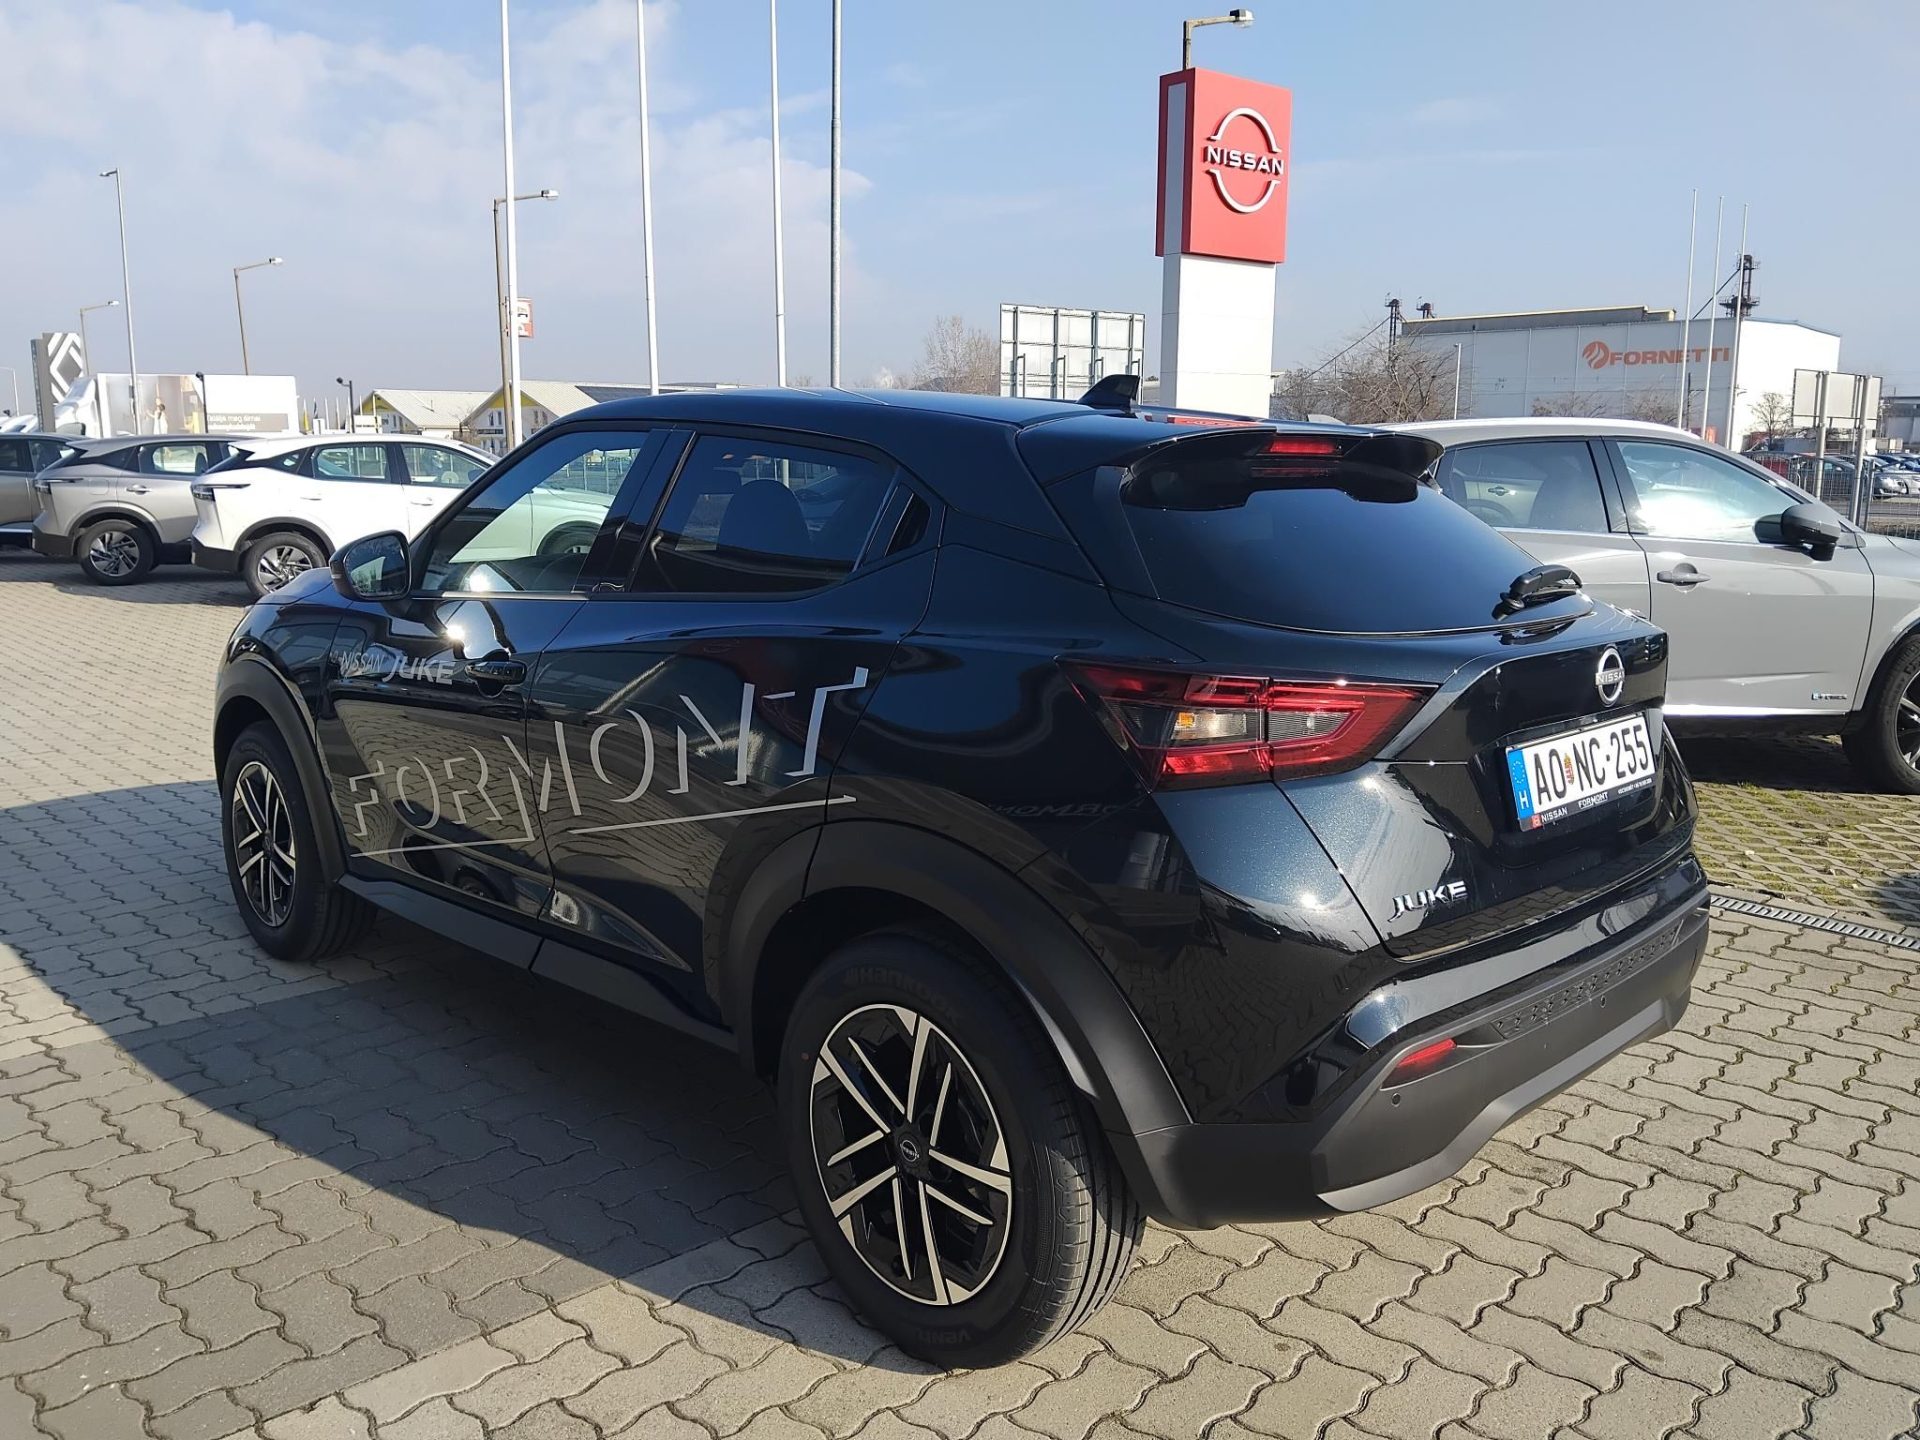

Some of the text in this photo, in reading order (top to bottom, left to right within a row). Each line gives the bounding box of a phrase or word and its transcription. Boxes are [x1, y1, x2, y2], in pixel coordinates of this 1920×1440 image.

[1204, 145, 1285, 175] NISSAN
[1609, 347, 1730, 366] FORNETTI
[341, 651, 456, 686] NISSAN JUKE
[348, 666, 869, 843] FORMONT
[1533, 748, 1567, 806] AO
[1518, 790, 1530, 810] H
[1578, 791, 1609, 808] FORMONT
[1541, 807, 1568, 823] NISSAN
[1387, 880, 1469, 923] JUKE
